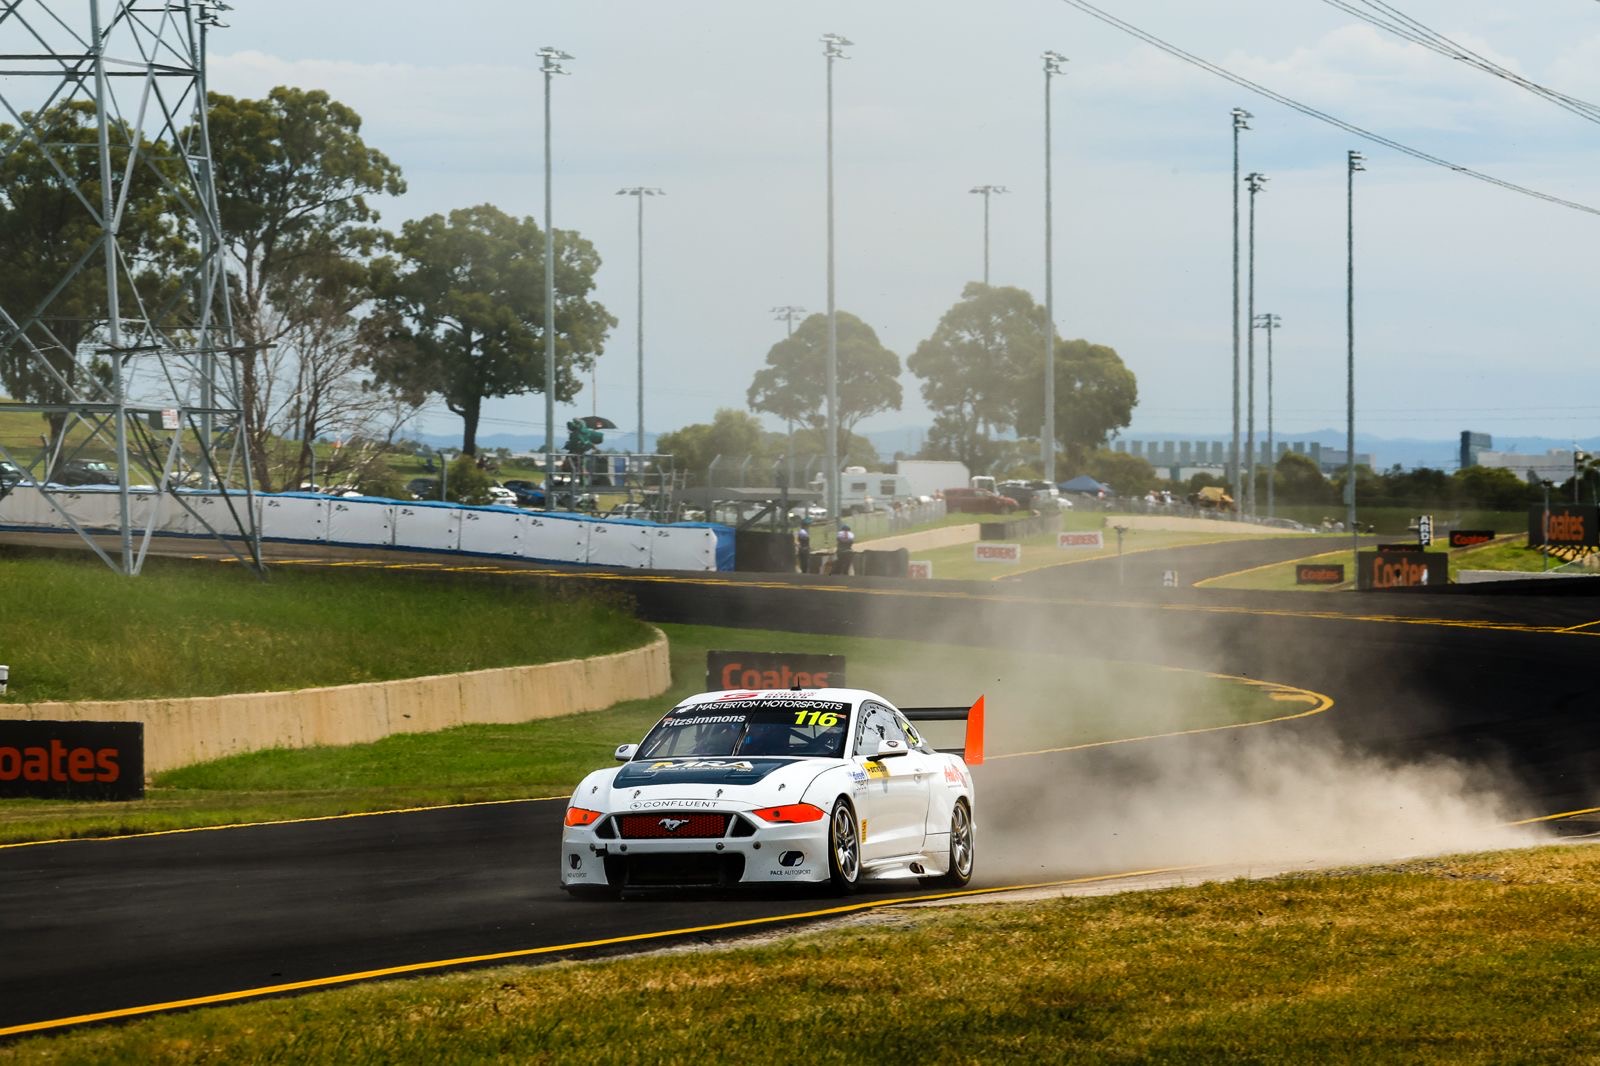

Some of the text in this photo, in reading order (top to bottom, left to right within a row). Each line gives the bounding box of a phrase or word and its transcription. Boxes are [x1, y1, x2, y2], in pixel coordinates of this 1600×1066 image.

[721, 663, 829, 689] Coates
[696, 700, 843, 711] MASTERTON MOTORSPORTS
[794, 710, 838, 727] 116
[643, 800, 719, 808] CONFLUENT
